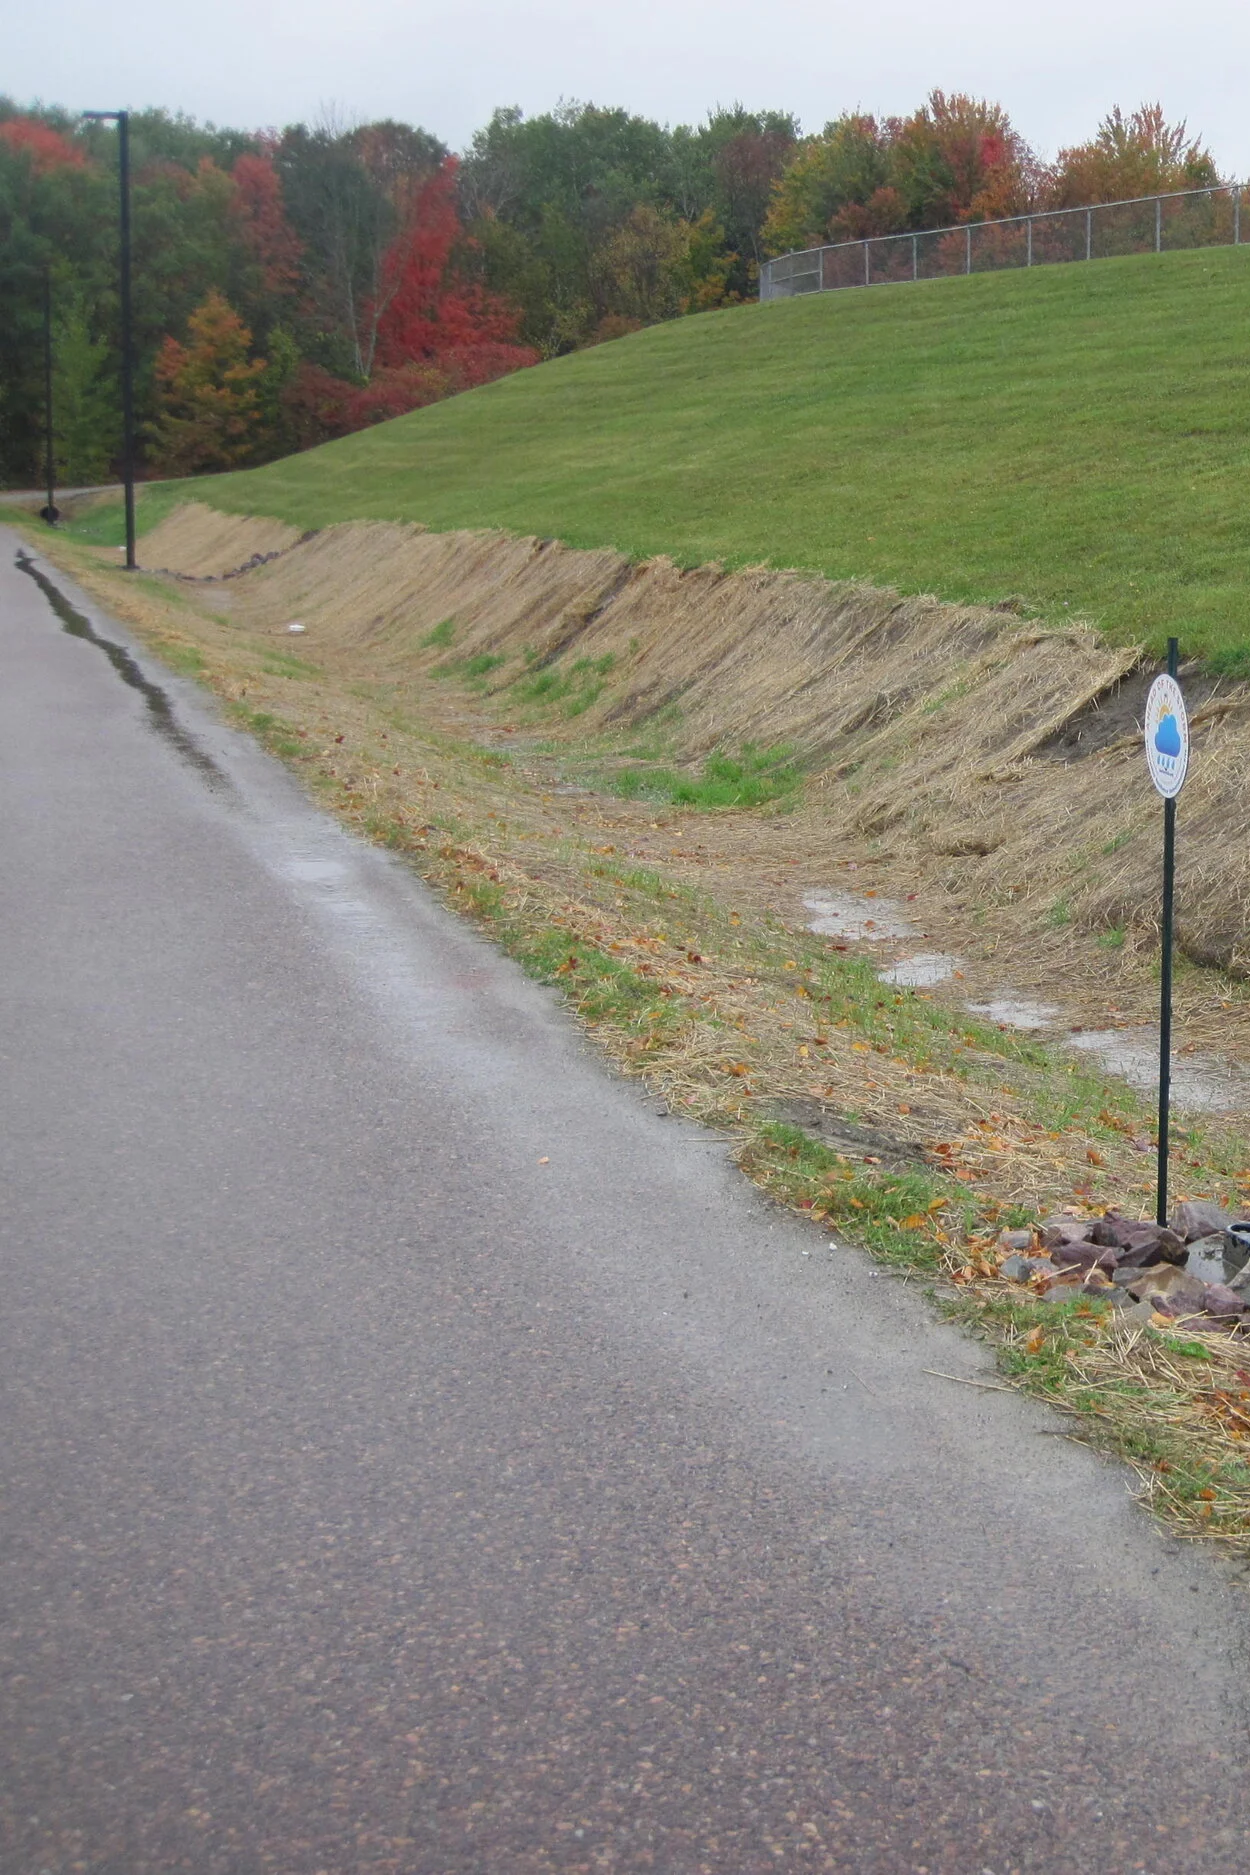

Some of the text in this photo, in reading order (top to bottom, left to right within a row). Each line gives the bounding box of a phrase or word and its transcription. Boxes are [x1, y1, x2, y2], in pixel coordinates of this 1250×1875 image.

[1146, 689, 1156, 730] AHEAD
[1157, 679, 1164, 692] OF
[1166, 679, 1177, 695] THE
